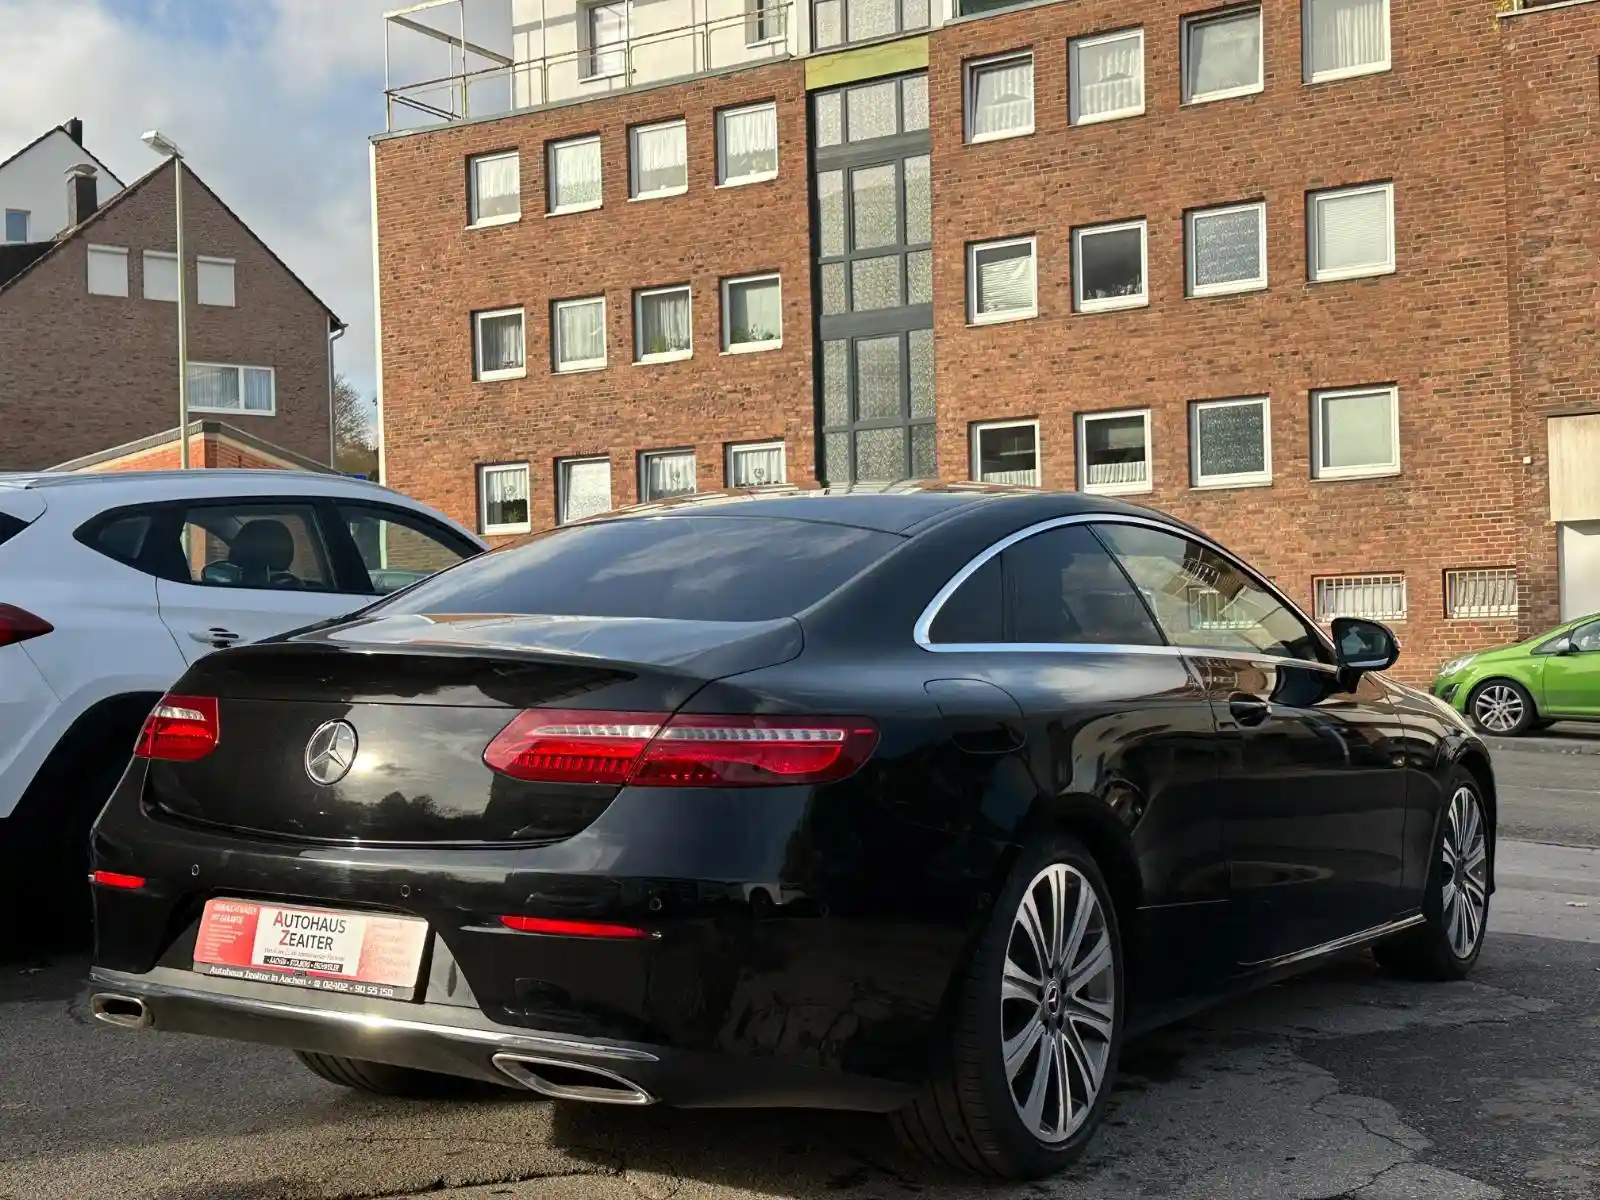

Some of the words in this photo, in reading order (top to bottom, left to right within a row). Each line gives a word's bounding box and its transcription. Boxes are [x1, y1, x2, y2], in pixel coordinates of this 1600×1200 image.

[273, 911, 346, 934] AUTOHAUS
[279, 930, 333, 951] ZEAITER
[209, 966, 243, 978] Autohaus
[244, 971, 270, 981] Zeaiter
[279, 974, 306, 985] Aachen
[323, 981, 348, 991] 02402
[354, 985, 365, 993] 90
[367, 987, 377, 995] 55
[380, 988, 393, 996] 150
